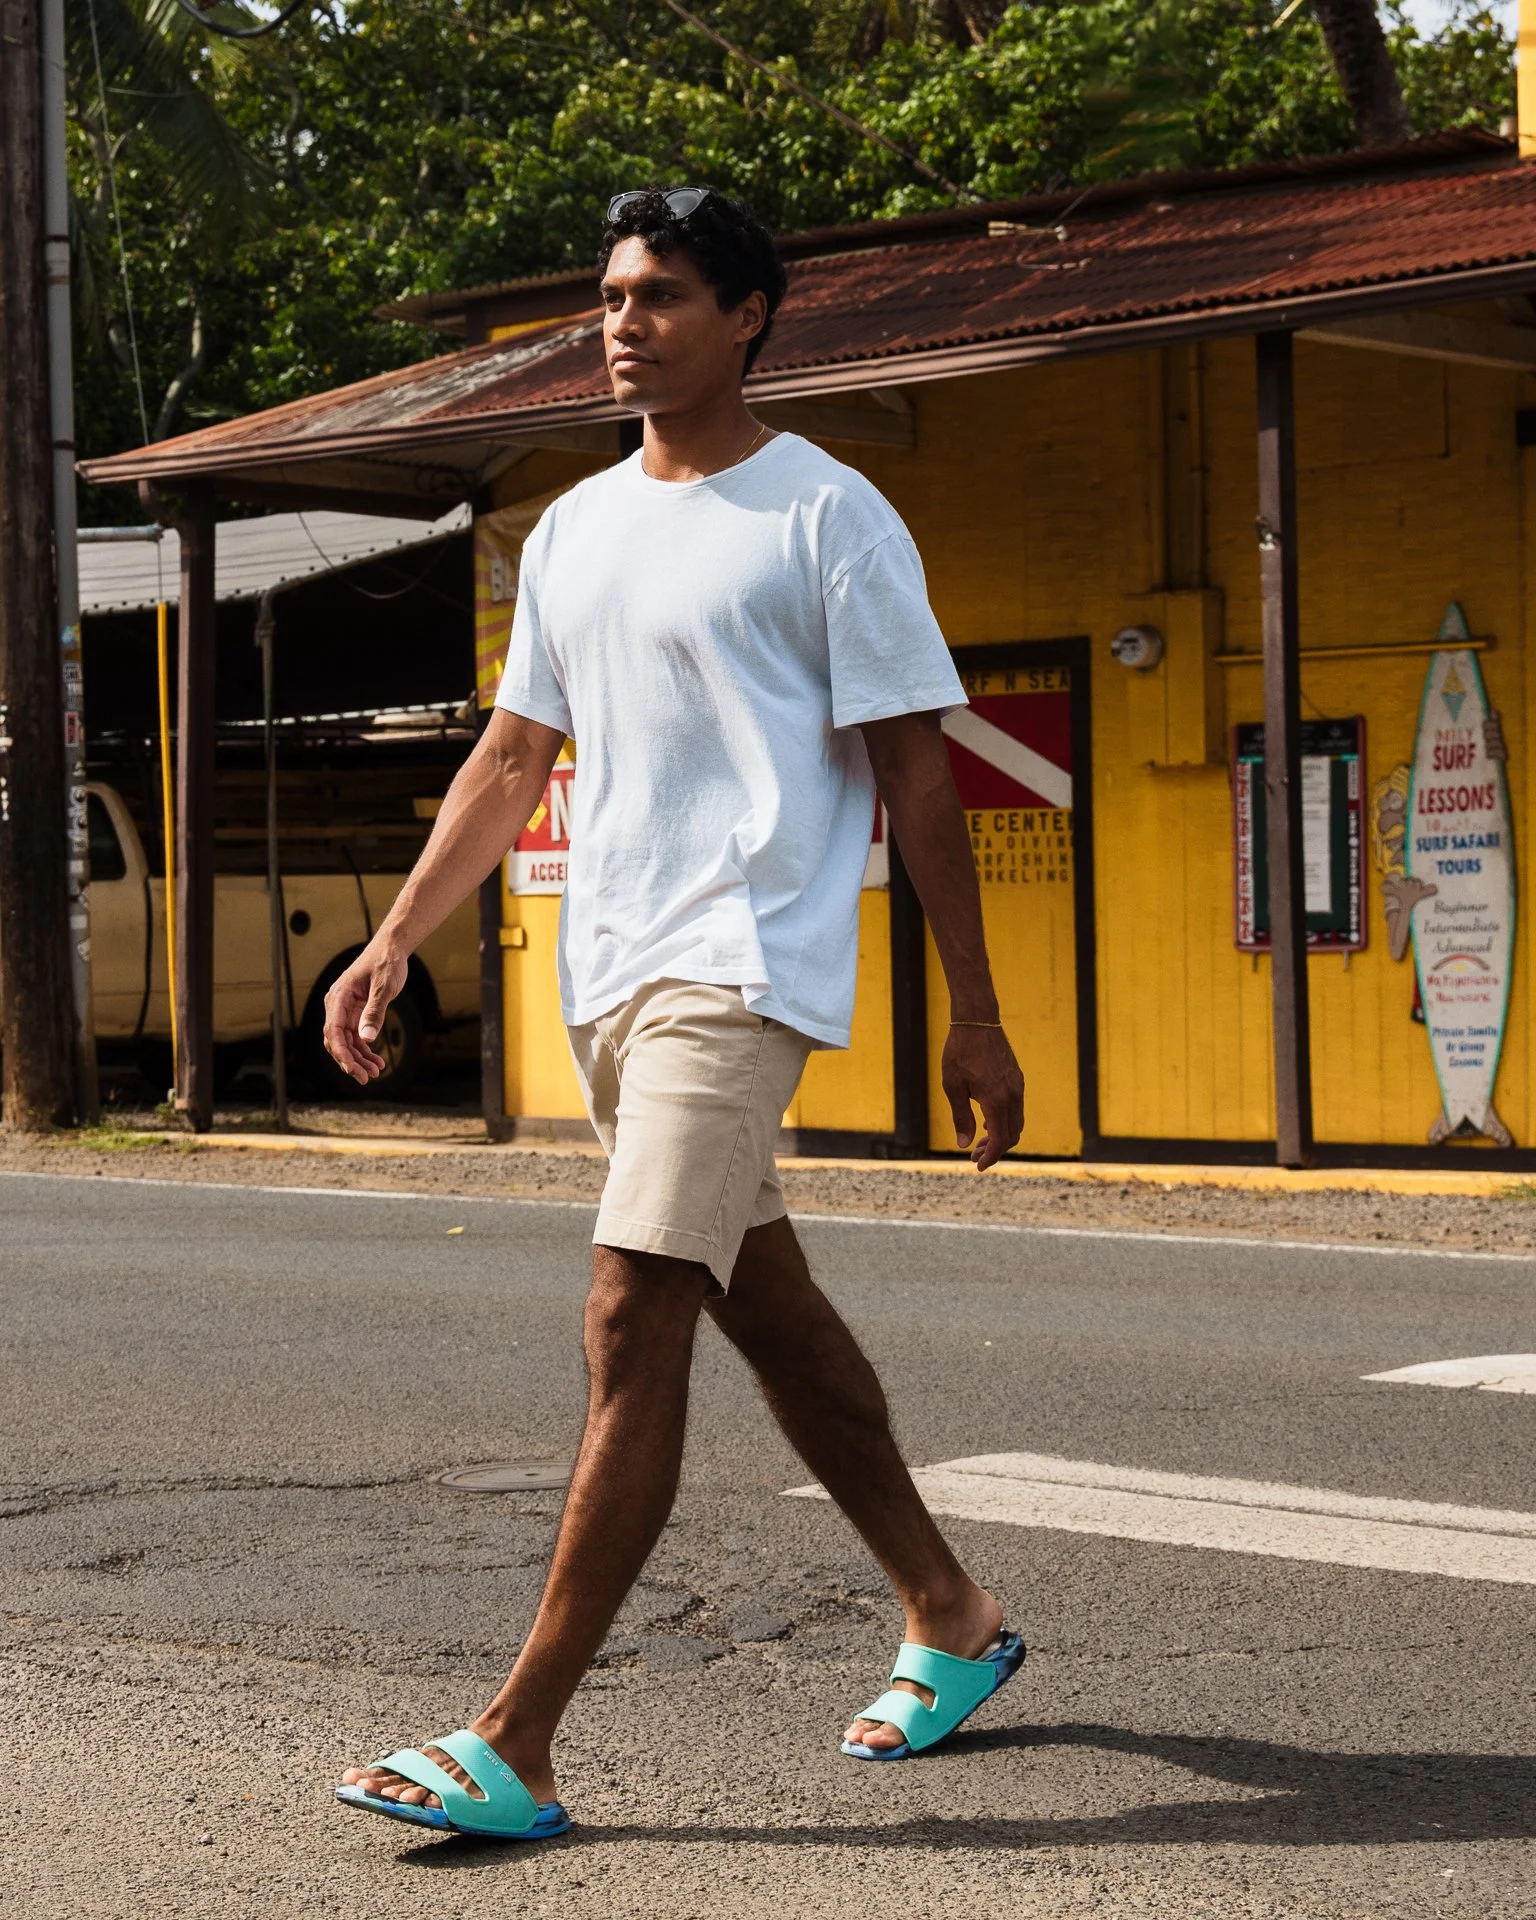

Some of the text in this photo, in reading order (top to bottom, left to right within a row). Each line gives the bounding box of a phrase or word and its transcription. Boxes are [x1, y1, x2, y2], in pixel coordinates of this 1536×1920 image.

[1005, 671, 1016, 692] N
[1029, 669, 1070, 689] SEA
[1433, 743, 1476, 771] SURF
[1418, 784, 1495, 814] LESSONS
[1416, 832, 1500, 852] SURF SAFARI
[977, 869, 1069, 883] RKELING
[1437, 858, 1482, 875] TOURS
